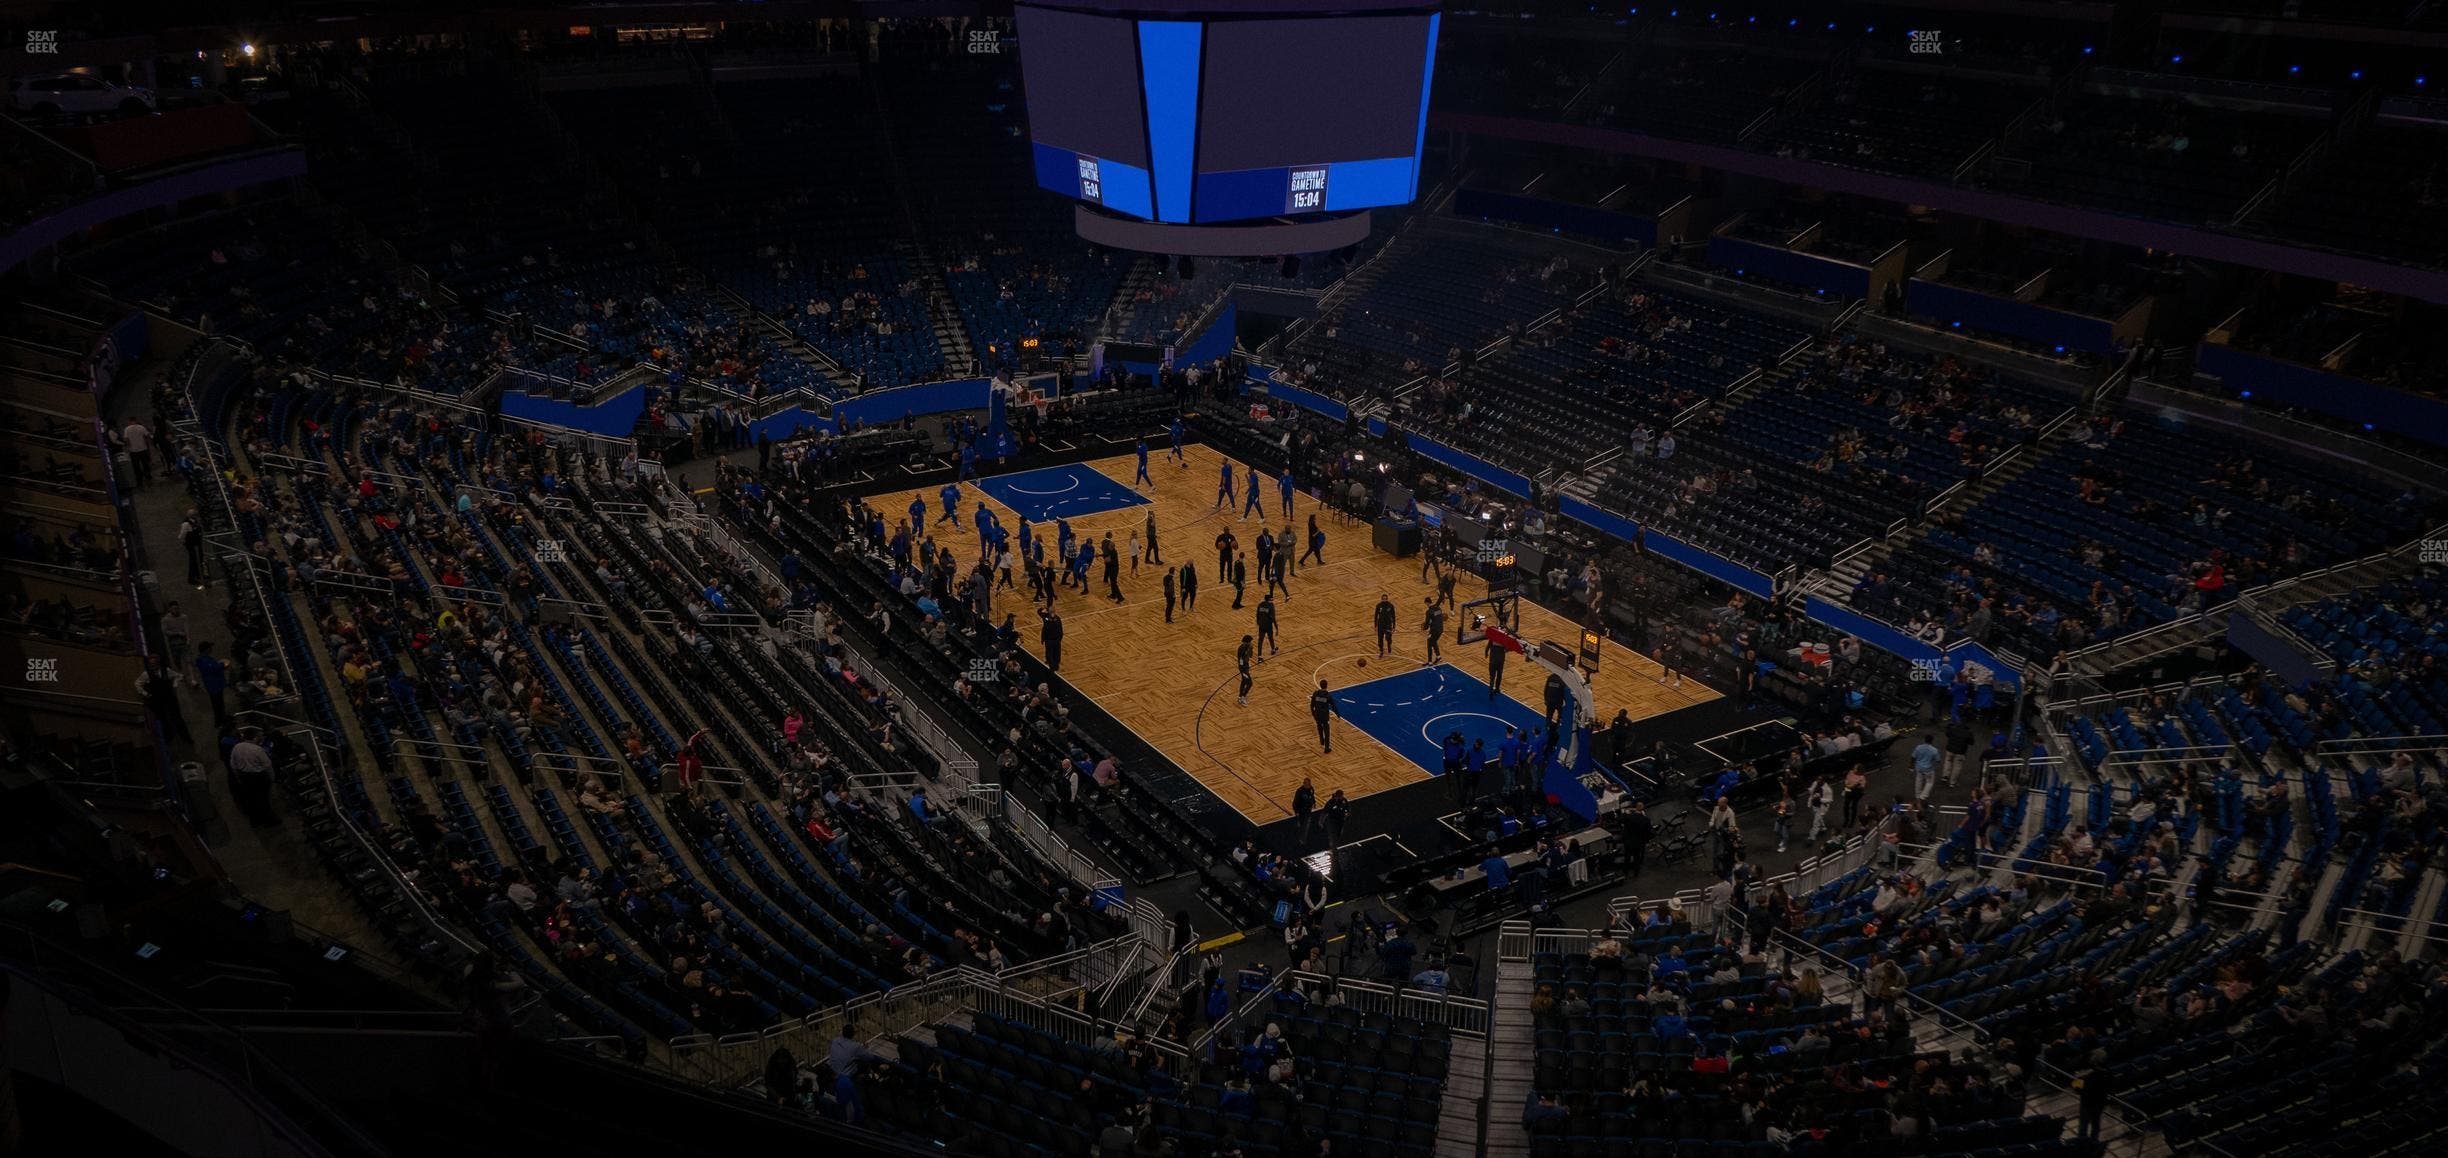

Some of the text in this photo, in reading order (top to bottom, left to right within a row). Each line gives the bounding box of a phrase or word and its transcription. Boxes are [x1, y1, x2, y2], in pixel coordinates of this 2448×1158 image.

[1292, 171, 1320, 180] COUNTDOWN
[1291, 178, 1325, 191] GAMETIME
[1294, 192, 1320, 208] 15:04
